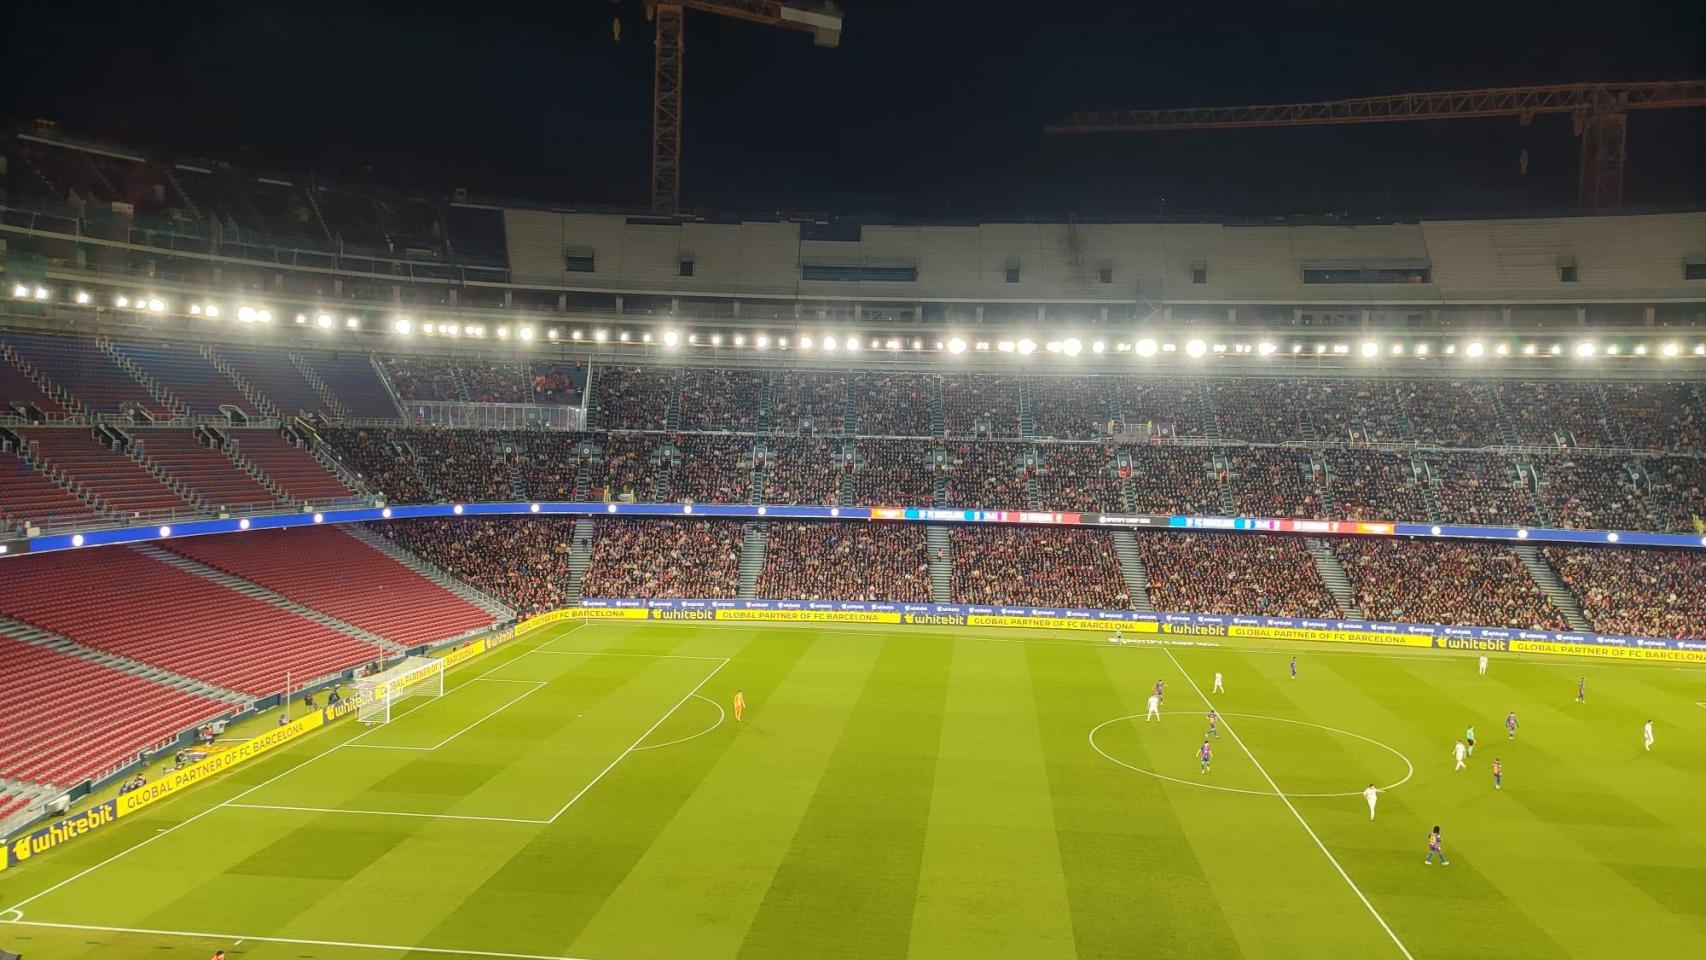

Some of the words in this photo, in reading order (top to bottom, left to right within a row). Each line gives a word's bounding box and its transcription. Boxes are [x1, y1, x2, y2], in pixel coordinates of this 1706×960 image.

[662, 609, 712, 619] whitebit
[827, 613, 878, 621] BARCELONA
[915, 614, 964, 625] whitebit
[1011, 619, 1051, 627] PARTNER
[1080, 622, 1135, 630] BARCELONA
[1173, 624, 1225, 636] whitebit
[1274, 631, 1316, 639] PARTNER
[1348, 634, 1407, 643] BARCELONA
[1449, 639, 1505, 651] whitebit
[1517, 644, 1558, 652] GLOBAL
[1561, 647, 1609, 655] PARTNER
[1612, 649, 1626, 657] OF
[1629, 650, 1642, 658] FC
[127, 782, 173, 809] GLOBAL
[175, 763, 222, 791] PARTNER
[223, 754, 237, 766] OF
[239, 746, 251, 760] FC
[253, 723, 304, 752] BARCELONA
[32, 804, 114, 854] whitebit
